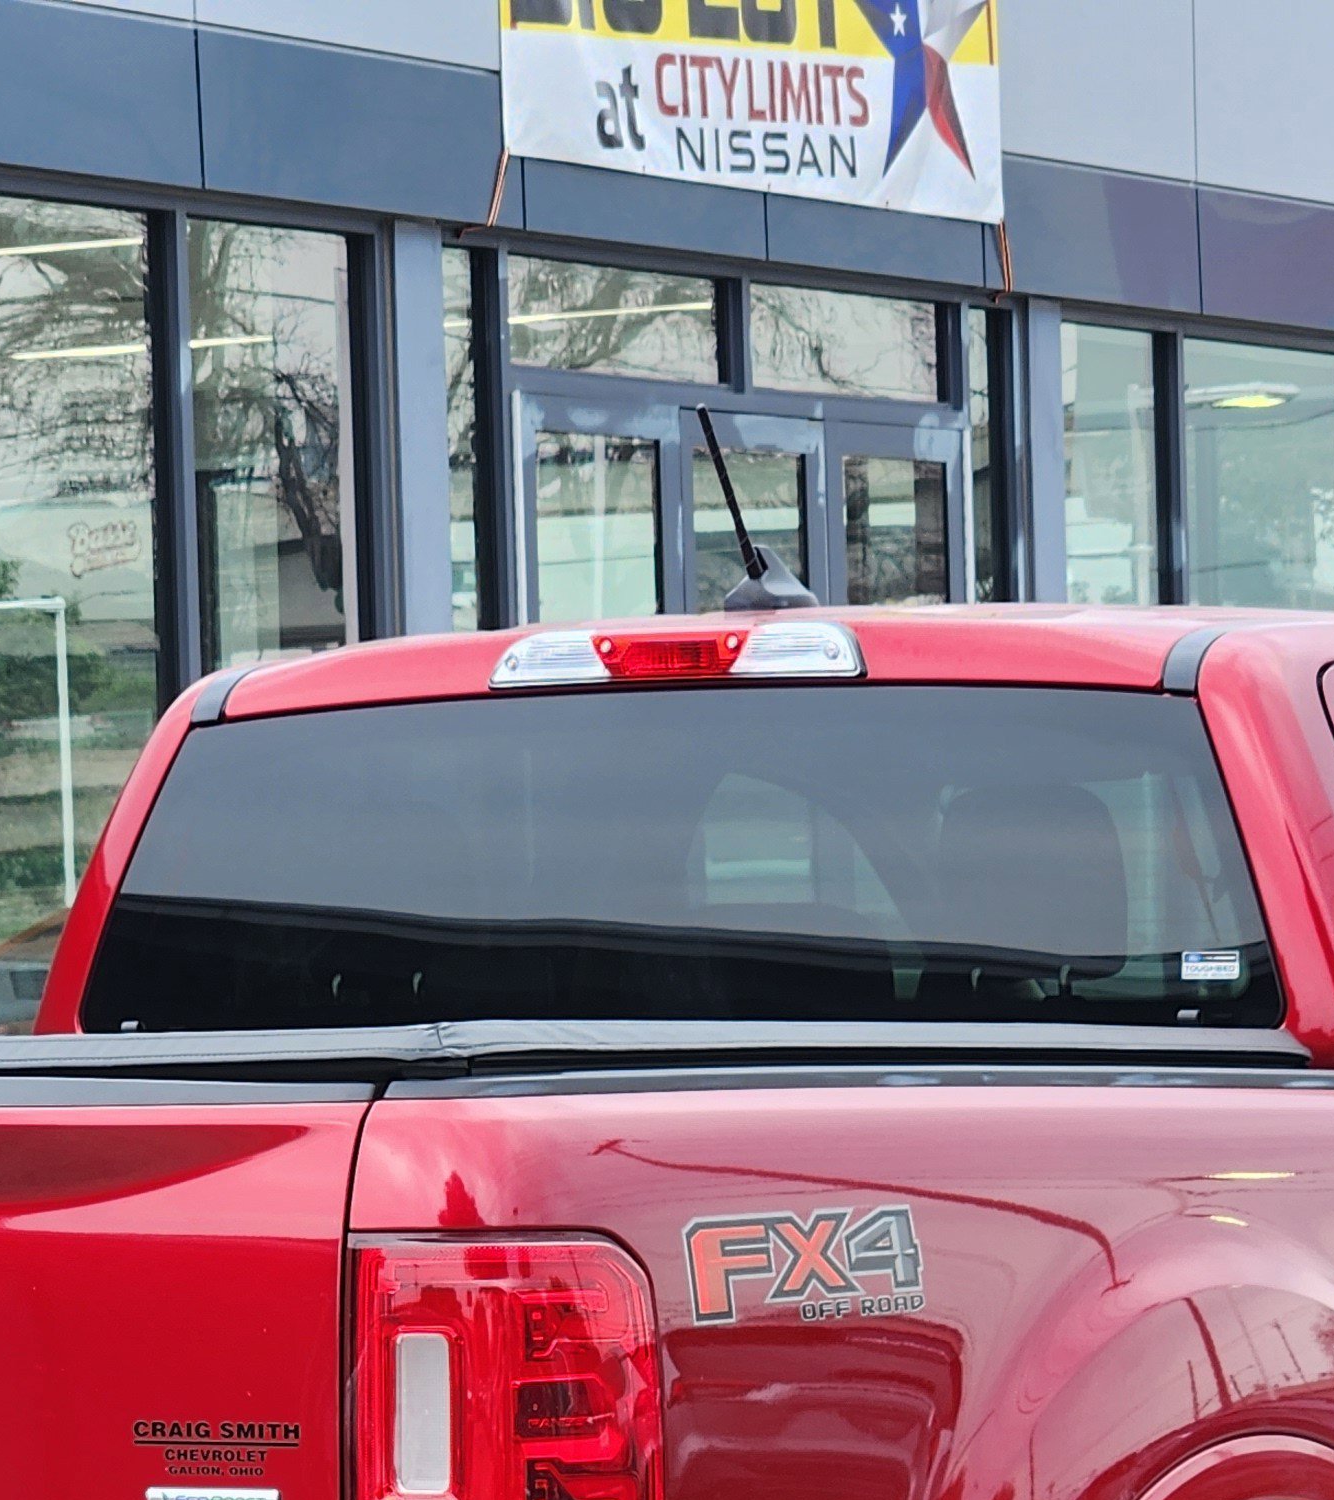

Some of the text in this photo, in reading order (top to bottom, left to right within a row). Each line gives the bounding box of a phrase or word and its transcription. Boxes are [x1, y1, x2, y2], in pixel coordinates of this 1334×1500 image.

[595, 64, 646, 150] at
[675, 126, 857, 178] NISSAN
[682, 1204, 923, 1325] FX4
[801, 1295, 925, 1321] OFF ROAD
[133, 1421, 300, 1439] CRAIG SMITH
[165, 1448, 267, 1462] CHEVROLET
[168, 1466, 264, 1476] GALION, OHIO
